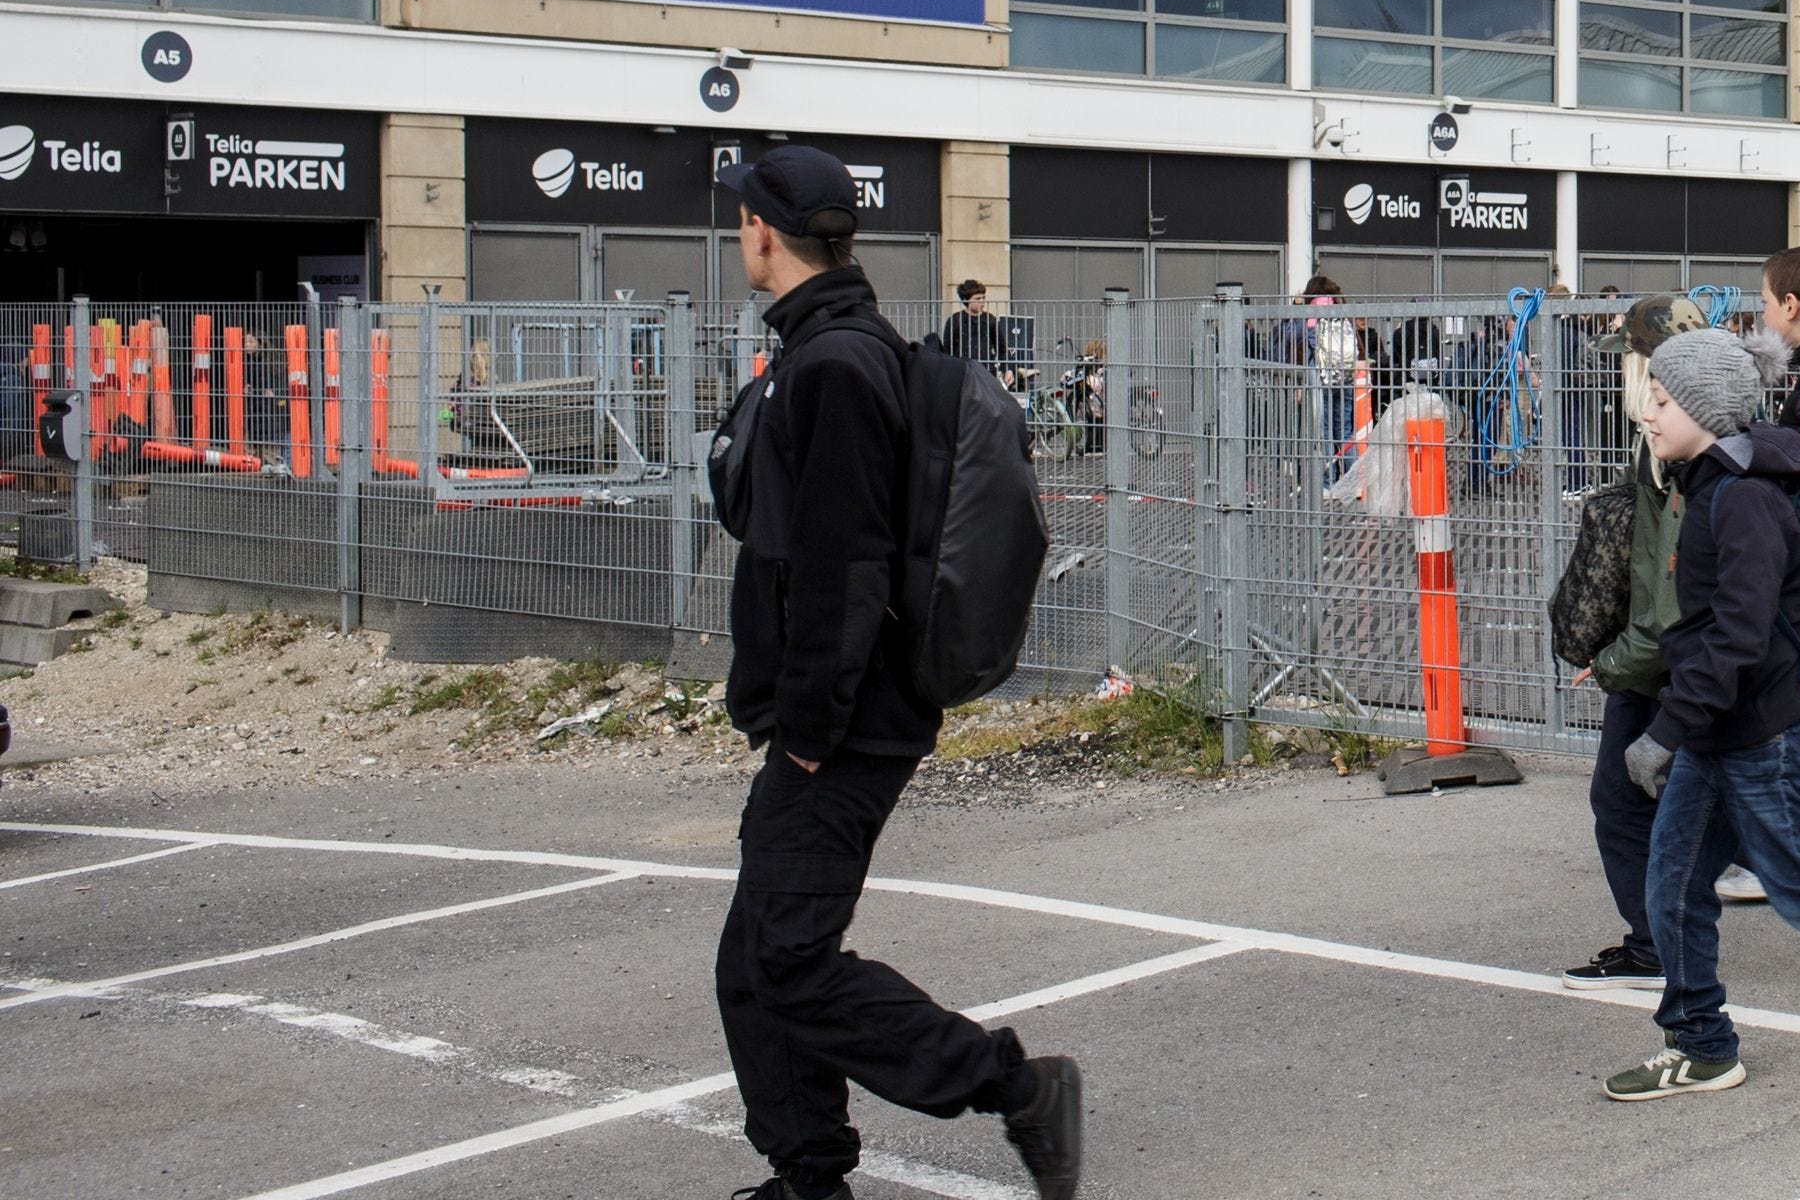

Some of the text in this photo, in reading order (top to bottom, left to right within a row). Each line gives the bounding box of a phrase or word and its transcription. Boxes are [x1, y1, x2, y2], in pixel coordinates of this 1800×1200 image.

[153, 49, 181, 65] A5
[708, 82, 731, 98] A6
[205, 133, 253, 154] Telia
[1432, 126, 1457, 140] A6A
[42, 140, 121, 173] Telia
[209, 156, 345, 192] PARKEN
[580, 161, 644, 192] Telia
[1376, 194, 1421, 219] Telia
[1450, 206, 1528, 230] PARKEN
